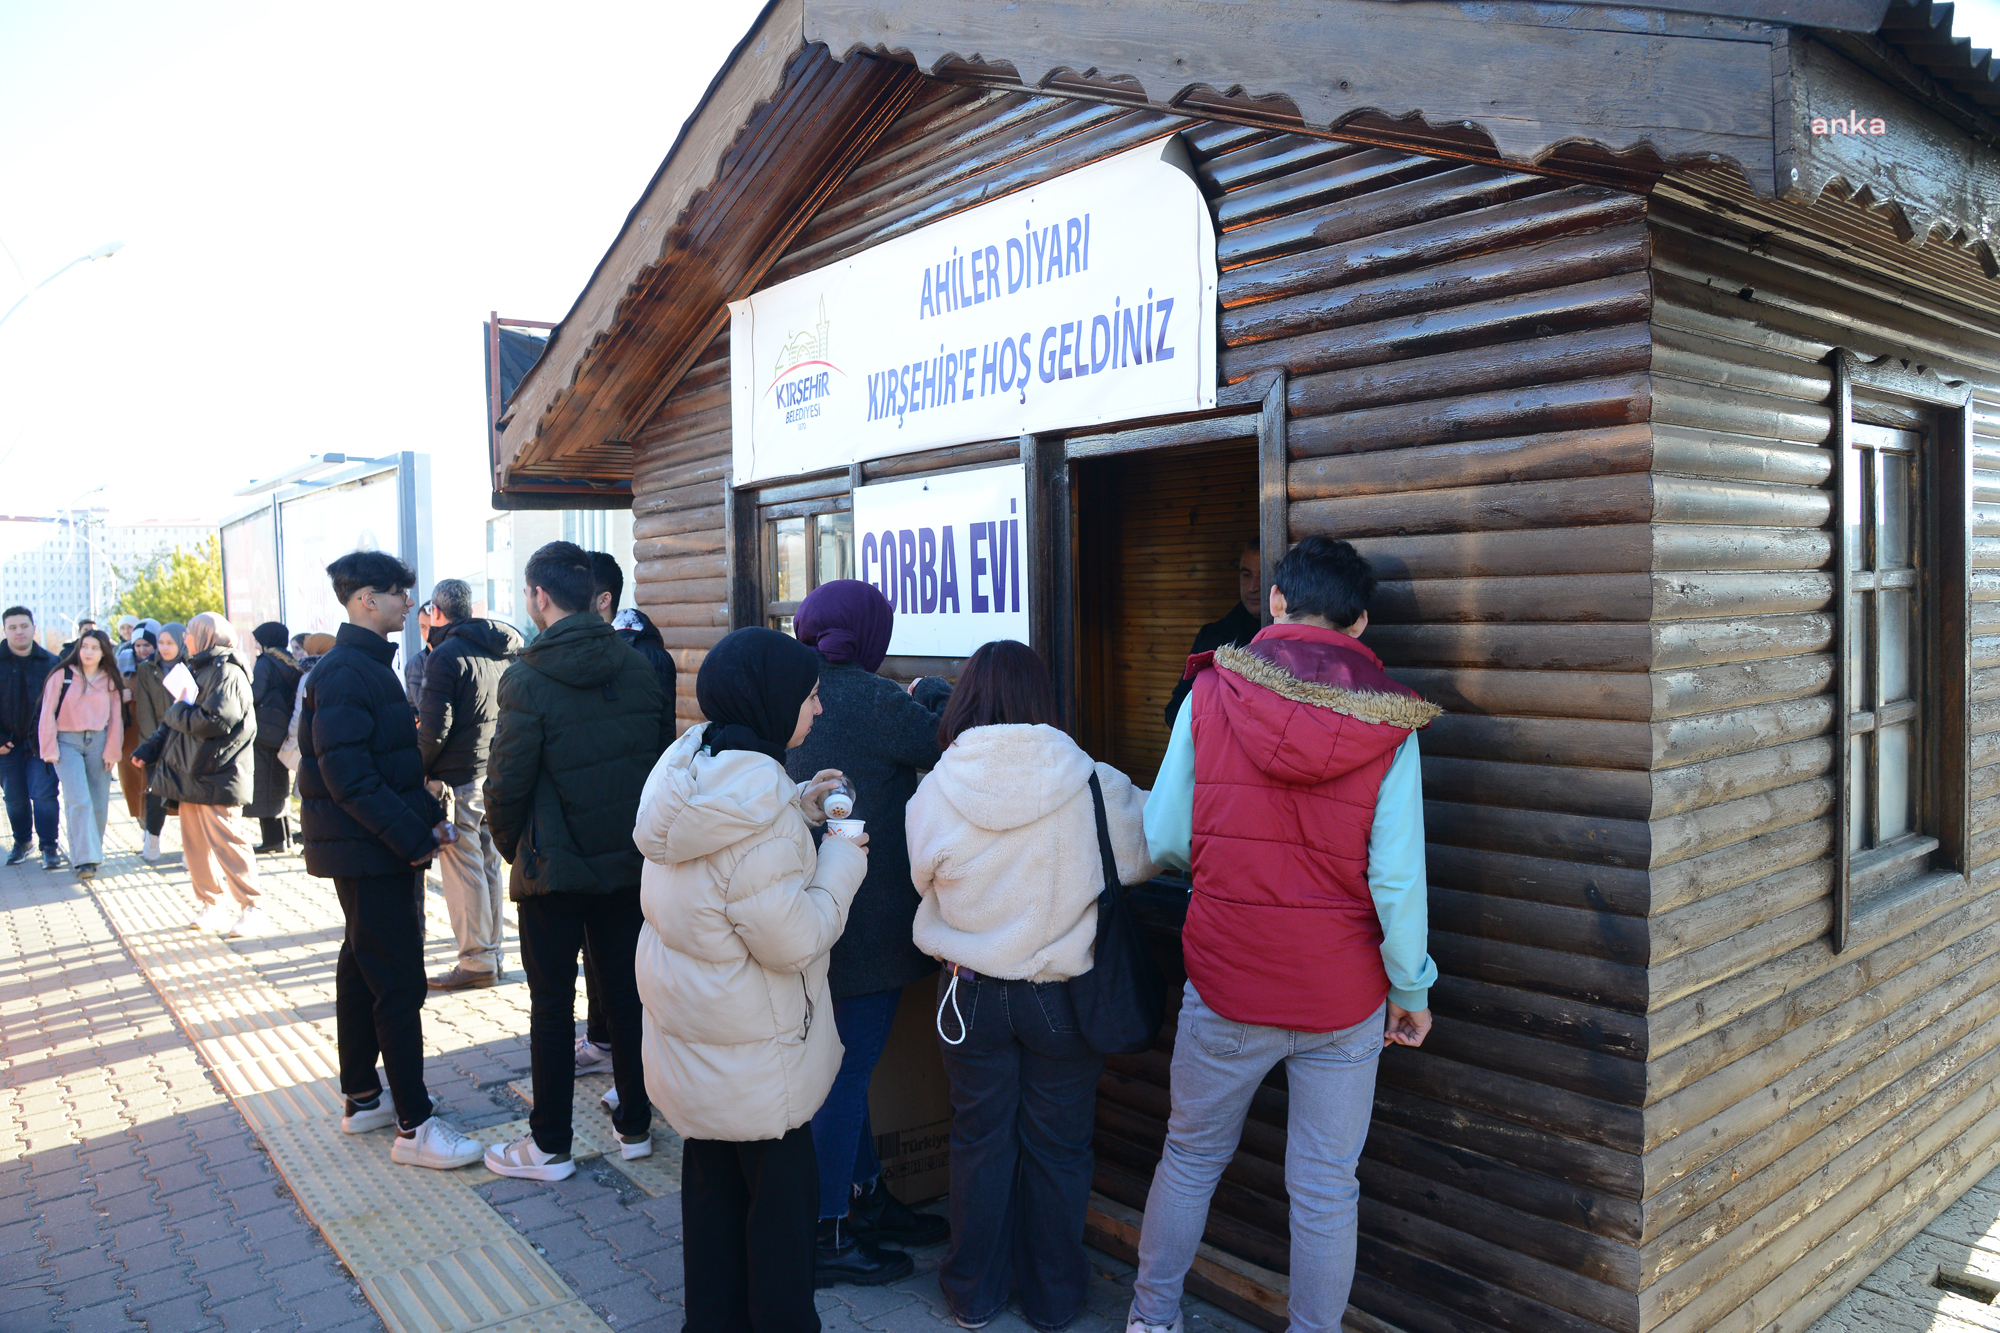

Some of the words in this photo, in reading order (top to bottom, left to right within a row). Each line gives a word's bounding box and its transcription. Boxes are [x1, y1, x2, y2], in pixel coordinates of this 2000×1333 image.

[919, 245, 1000, 320] AHİLER
[1006, 213, 1090, 295] DİYARI
[867, 343, 976, 429] KIRŞEHİR'E
[980, 332, 1031, 405] HOŞ
[1038, 287, 1175, 383] GELDİNİZ
[970, 498, 1020, 613] EVİ
[901, 1133, 950, 1154] Türkiye
